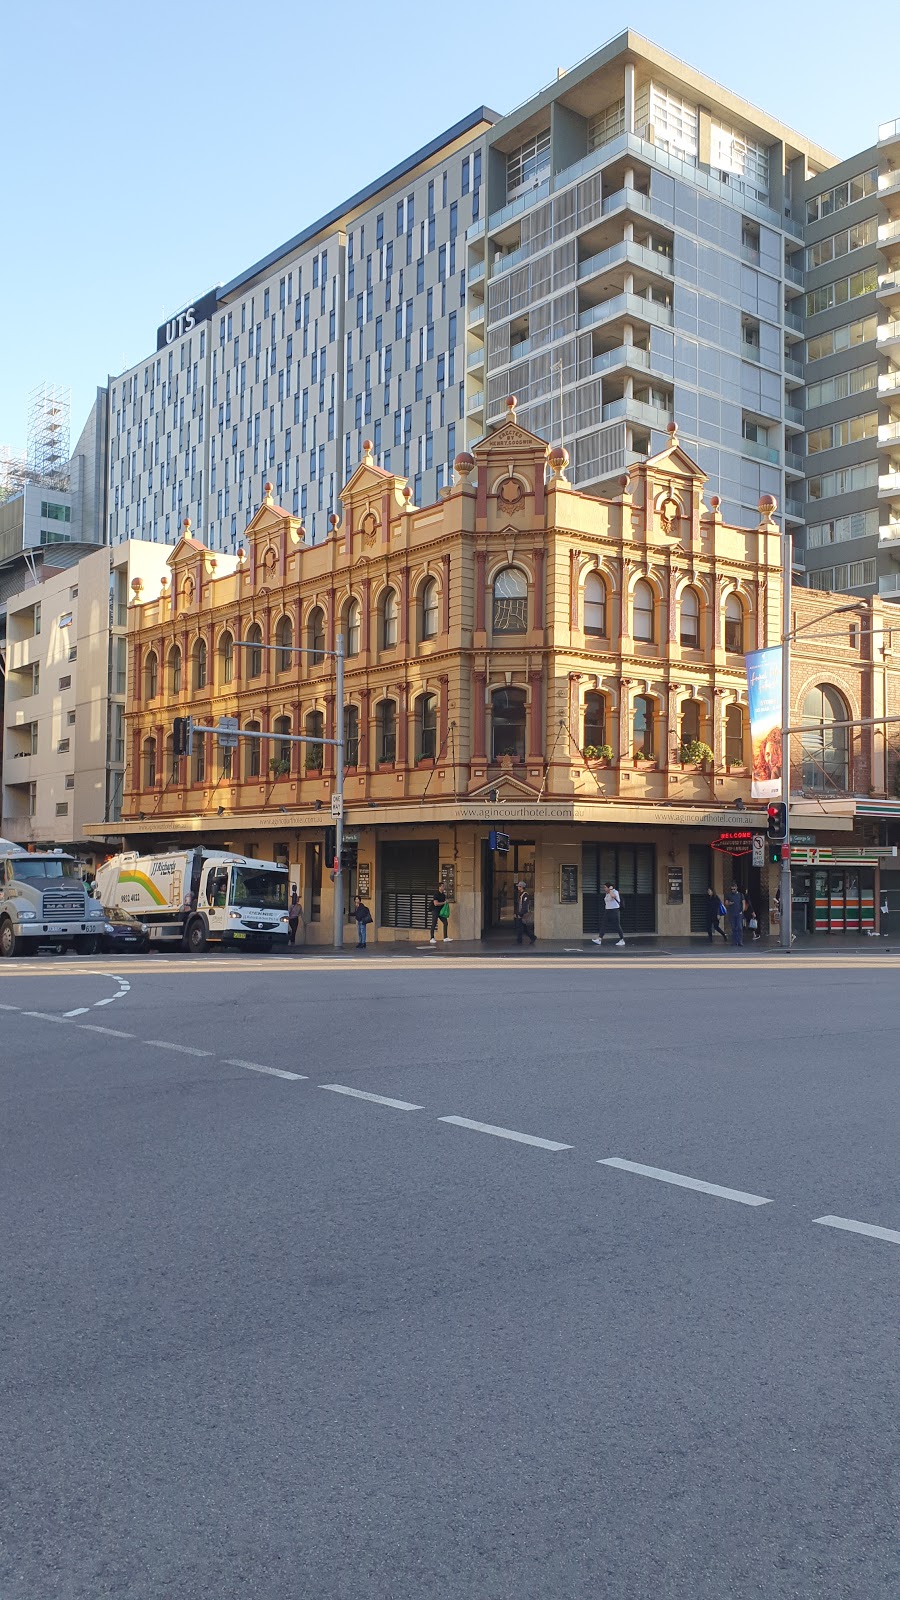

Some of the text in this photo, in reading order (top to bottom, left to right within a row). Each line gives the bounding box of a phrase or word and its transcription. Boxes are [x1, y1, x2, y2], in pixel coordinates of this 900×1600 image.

[166, 307, 196, 344] UTS
[498, 430, 523, 440] ERECTED
[455, 807, 585, 819] www.agincourthotel.com.au
[654, 813, 753, 824] www.agincourthotel.com.au
[86, 925, 96, 933] 630
